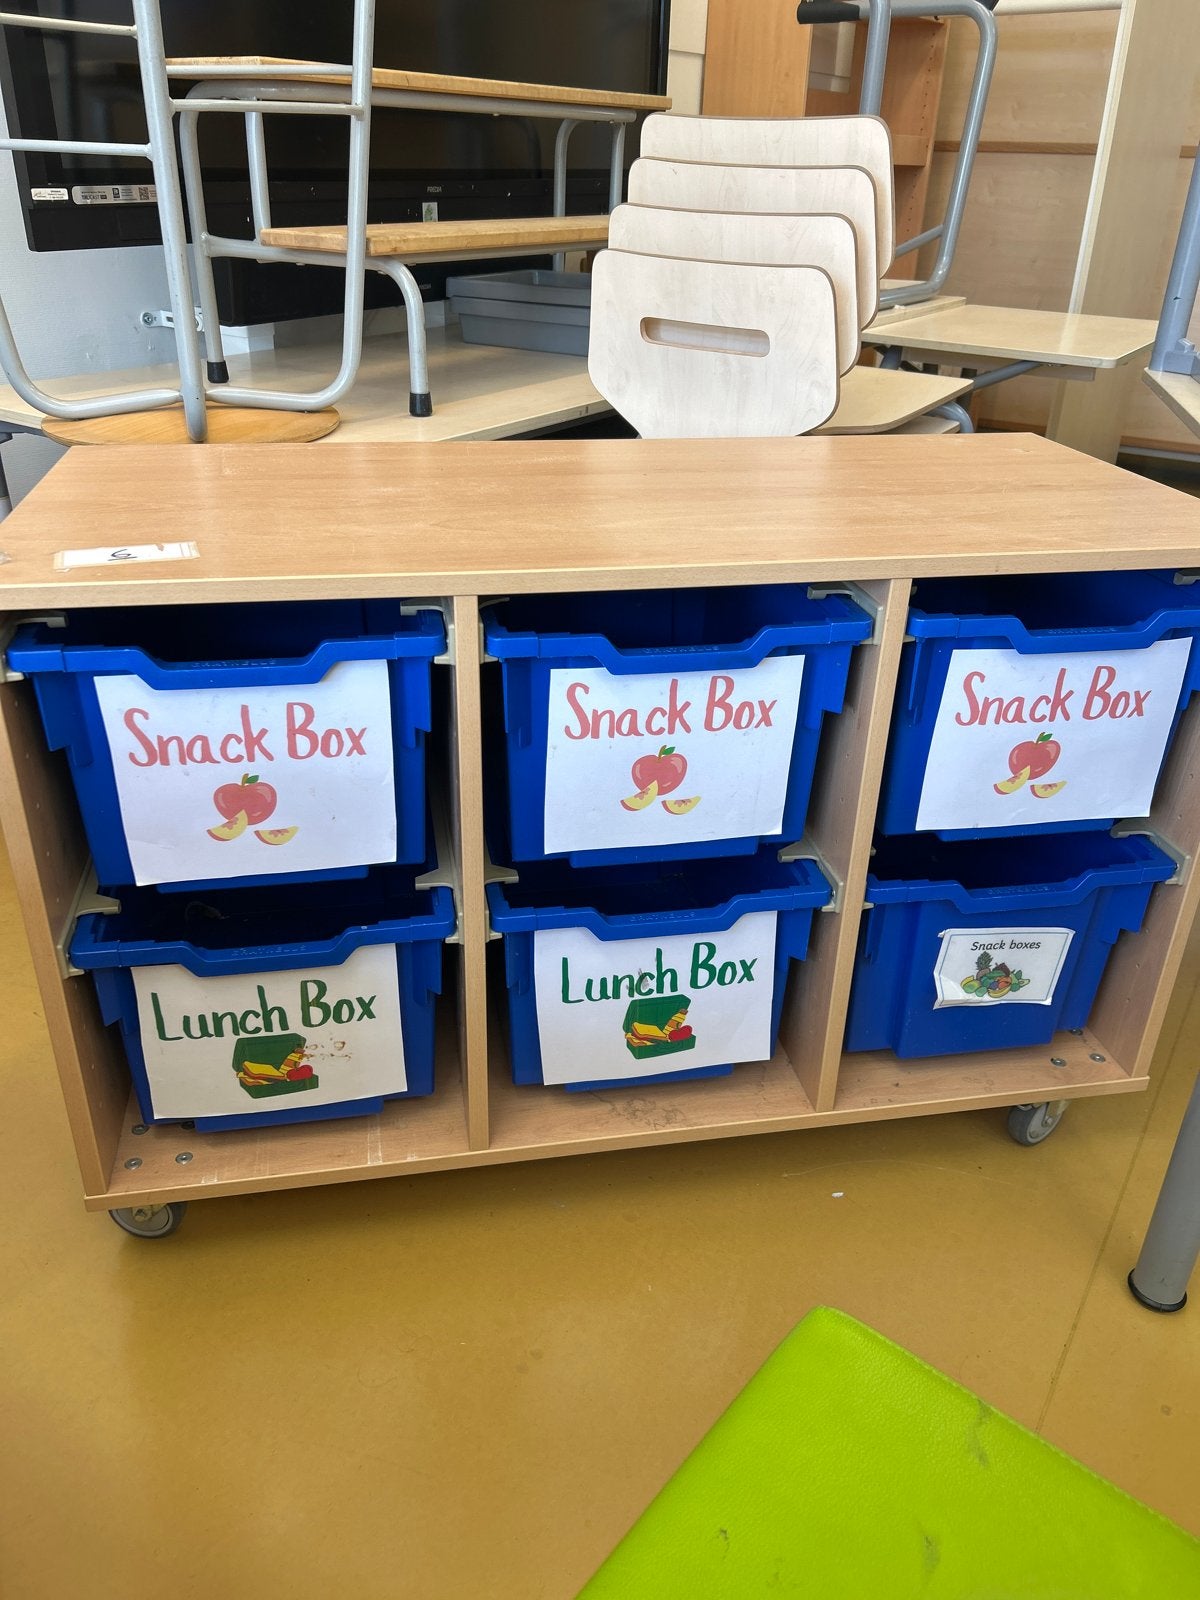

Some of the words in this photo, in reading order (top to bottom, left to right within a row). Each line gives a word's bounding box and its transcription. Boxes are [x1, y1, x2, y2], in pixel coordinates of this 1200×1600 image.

[564, 678, 692, 740] Snack
[703, 675, 778, 732] Box
[955, 667, 1074, 726] Snack
[1082, 665, 1152, 720] Box
[123, 704, 275, 767] Snack
[286, 702, 368, 760] Box
[562, 947, 679, 1004] Lunch
[689, 941, 758, 990] Box
[970, 940, 1006, 951] Snack
[1009, 940, 1041, 950] boxes
[151, 984, 290, 1041] Lunch
[300, 979, 377, 1028] Box
